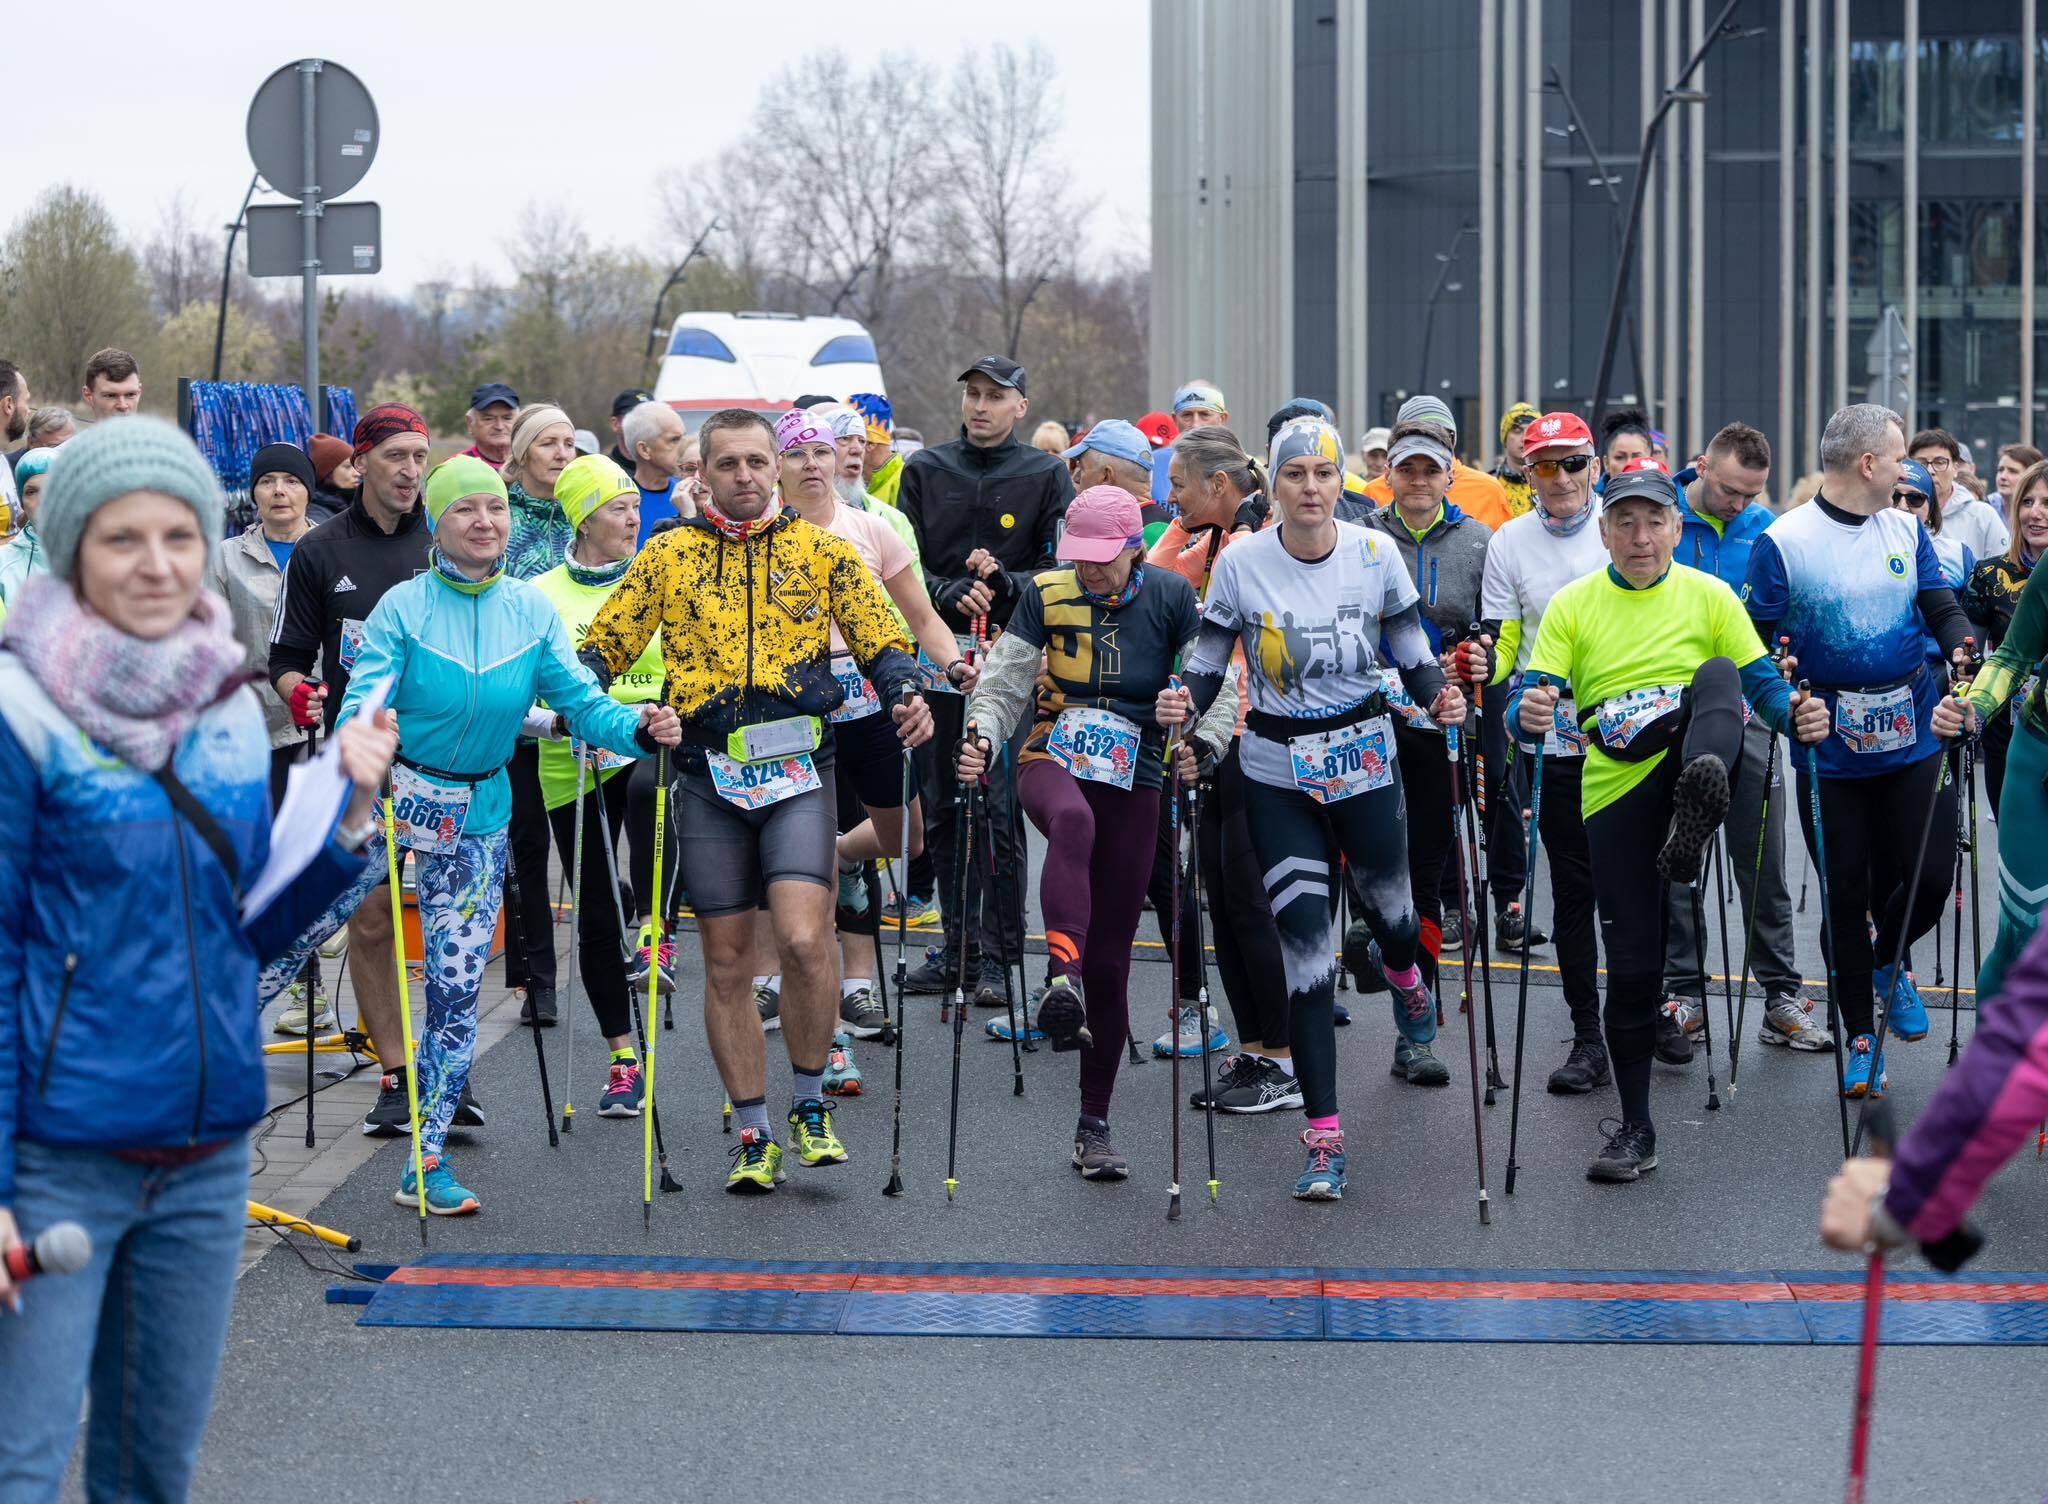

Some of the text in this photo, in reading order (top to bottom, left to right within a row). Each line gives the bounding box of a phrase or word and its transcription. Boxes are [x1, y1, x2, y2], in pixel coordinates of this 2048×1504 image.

[334, 584, 357, 593] adidas
[779, 589, 812, 597] RUNAWAYS
[622, 673, 652, 688] ręce
[842, 677, 863, 701] 73
[1863, 711, 1894, 734] 817
[1073, 730, 1116, 760] 832
[740, 759, 785, 788] 824
[1323, 748, 1361, 779] 870
[395, 797, 444, 831] 866
[655, 822, 663, 863] GABEL
